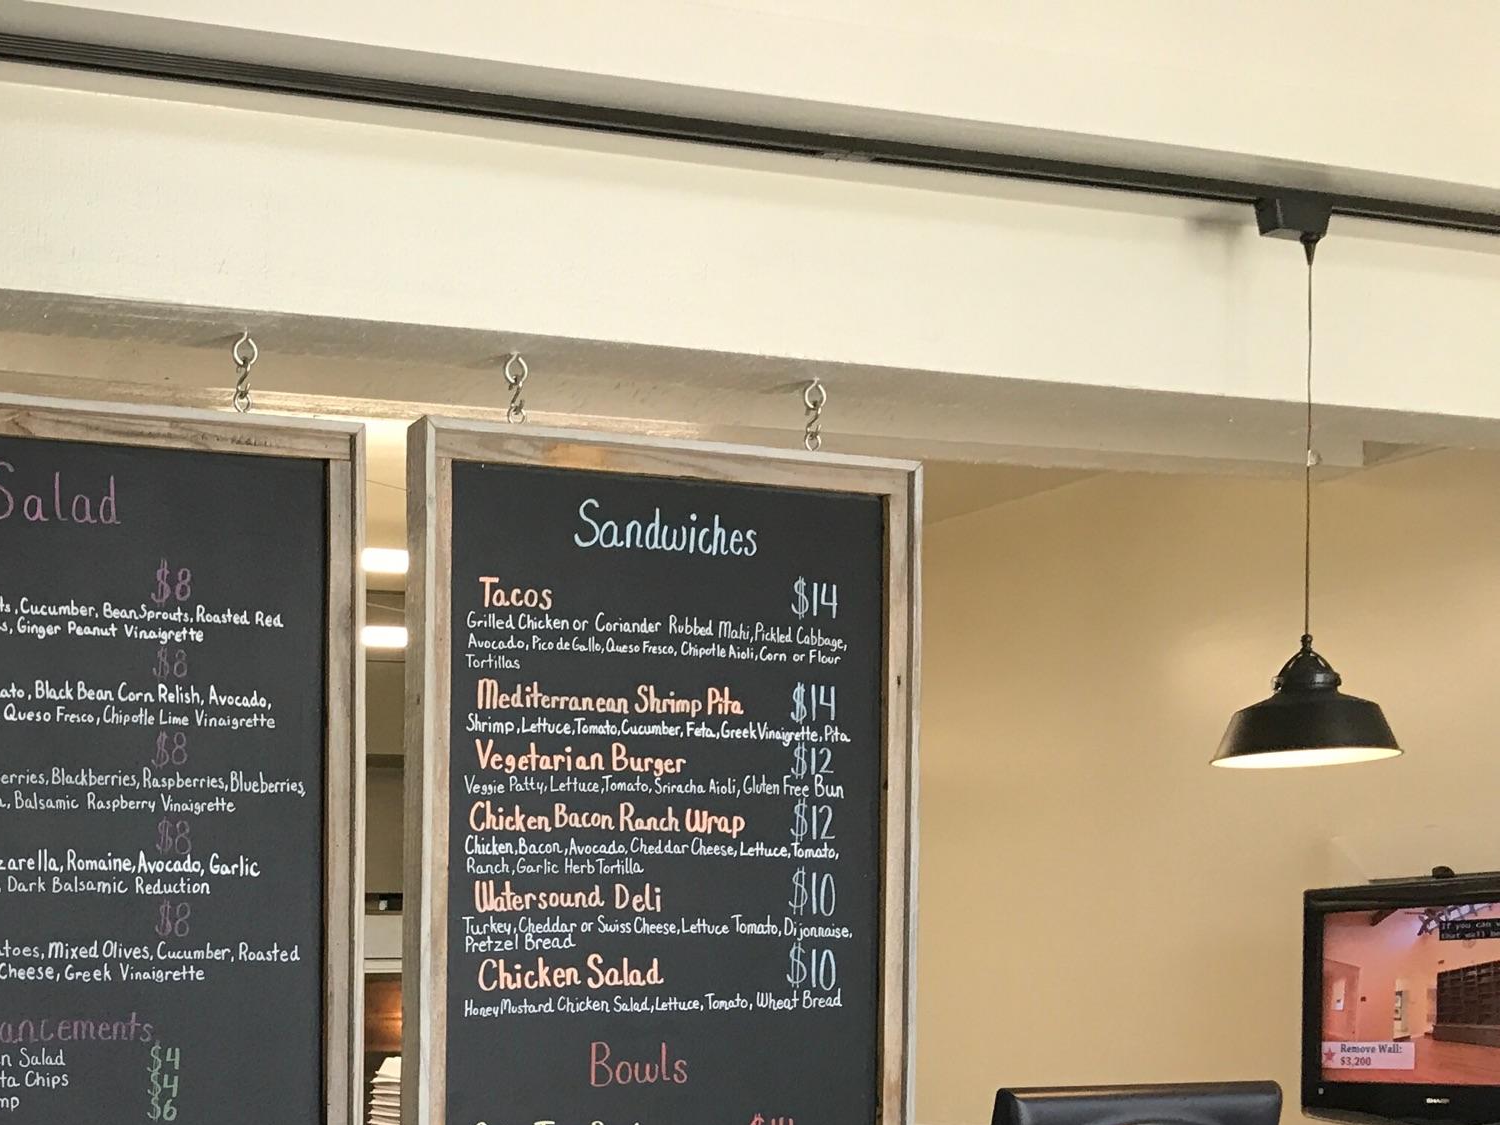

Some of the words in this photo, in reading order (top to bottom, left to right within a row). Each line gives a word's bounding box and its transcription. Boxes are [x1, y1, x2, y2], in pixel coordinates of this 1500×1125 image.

[574, 498, 758, 557] Sandwiches
[151, 558, 192, 603] $8
[478, 576, 554, 610] Tacos
[790, 576, 838, 620] $14
[17, 618, 62, 637] Ginger
[67, 620, 118, 638] Peanut
[124, 622, 204, 645] Vinaigrette
[466, 611, 516, 630] Grilled
[518, 612, 571, 631] Chicken
[573, 617, 589, 631] or
[595, 613, 662, 634] Coriander
[669, 617, 715, 638] Rubbed
[718, 619, 754, 641] Mahi,
[754, 623, 794, 643] Pickled
[796, 626, 848, 651] Cabbage,
[153, 646, 188, 680] $8
[465, 654, 521, 670] Tortillas
[34, 680, 76, 701] Black
[77, 682, 115, 703] Bean
[118, 682, 154, 704] Corn
[157, 683, 205, 706] Relish,
[209, 690, 273, 710] Avocado,
[476, 678, 629, 714] Mediterranean
[634, 684, 703, 719] Shrimp
[706, 686, 744, 716] Pita
[789, 680, 837, 726] $14
[152, 729, 188, 770] $8
[475, 738, 604, 773] Vegetarian
[610, 742, 687, 775] Burger
[790, 742, 835, 778] $12
[155, 817, 192, 856] $8
[469, 800, 553, 833] Chicken
[553, 799, 615, 830] Bacon
[619, 802, 680, 833] Ranch
[684, 808, 746, 838] Wrap
[789, 797, 837, 842] $12
[67, 853, 136, 875] Romaine,
[137, 852, 207, 877] Avocado,
[210, 853, 261, 878] Garlic
[7, 876, 47, 894] Dark
[51, 876, 129, 895] Balsamic
[135, 878, 211, 895] Reduction
[473, 879, 605, 913] Watersound
[614, 885, 662, 913] Deli
[788, 866, 836, 916] $10
[155, 899, 191, 938] $8
[464, 933, 519, 953] Pretzel
[524, 933, 576, 950] Bread
[64, 961, 112, 982] Greek
[119, 962, 205, 982] Vinaigrette
[477, 957, 582, 991] Chicken
[586, 952, 664, 988] Salad
[786, 943, 837, 991] $10
[590, 1040, 688, 1088] Bowls
[1340, 1044, 1376, 1053] Remove
[1378, 1044, 1403, 1053] Wall:
[1340, 1056, 1371, 1067] $3,200
[24, 1070, 70, 1092] Chips
[148, 1071, 179, 1099] $4
